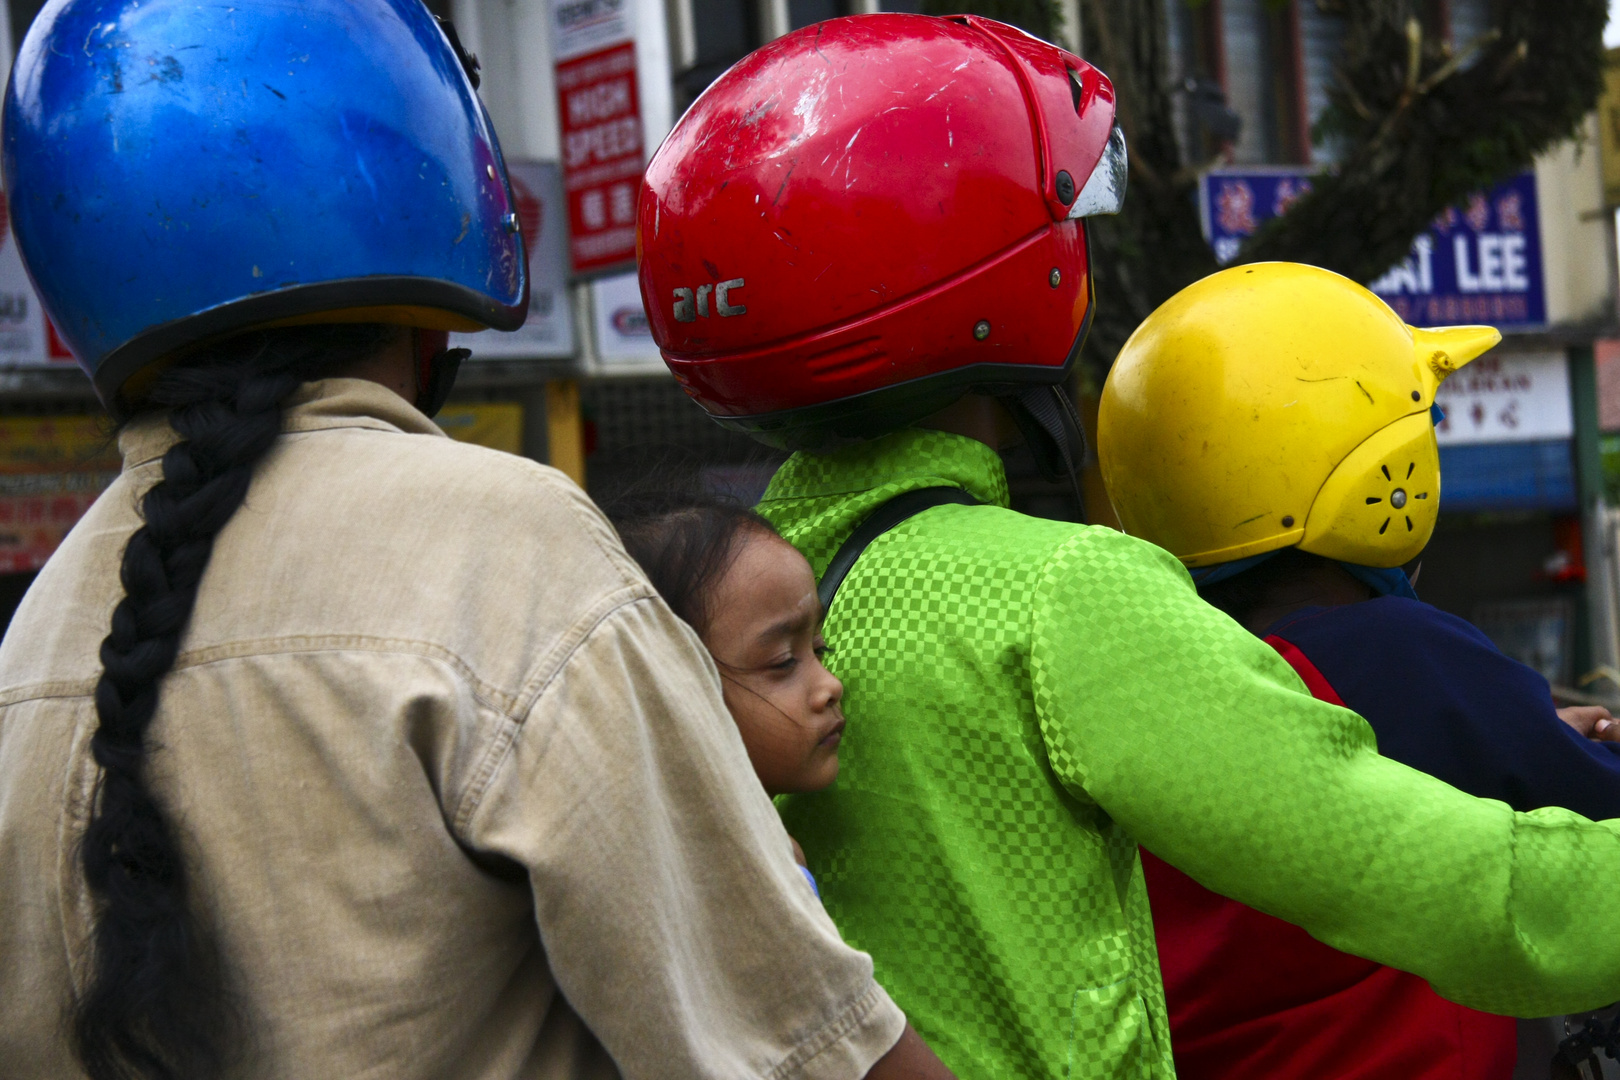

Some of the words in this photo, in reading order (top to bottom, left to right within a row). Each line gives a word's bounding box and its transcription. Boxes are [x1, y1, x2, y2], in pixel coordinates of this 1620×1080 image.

[568, 79, 631, 124] HIGH
[566, 115, 637, 167] SPEED
[1453, 233, 1528, 293] LEE
[673, 278, 746, 322] arc
